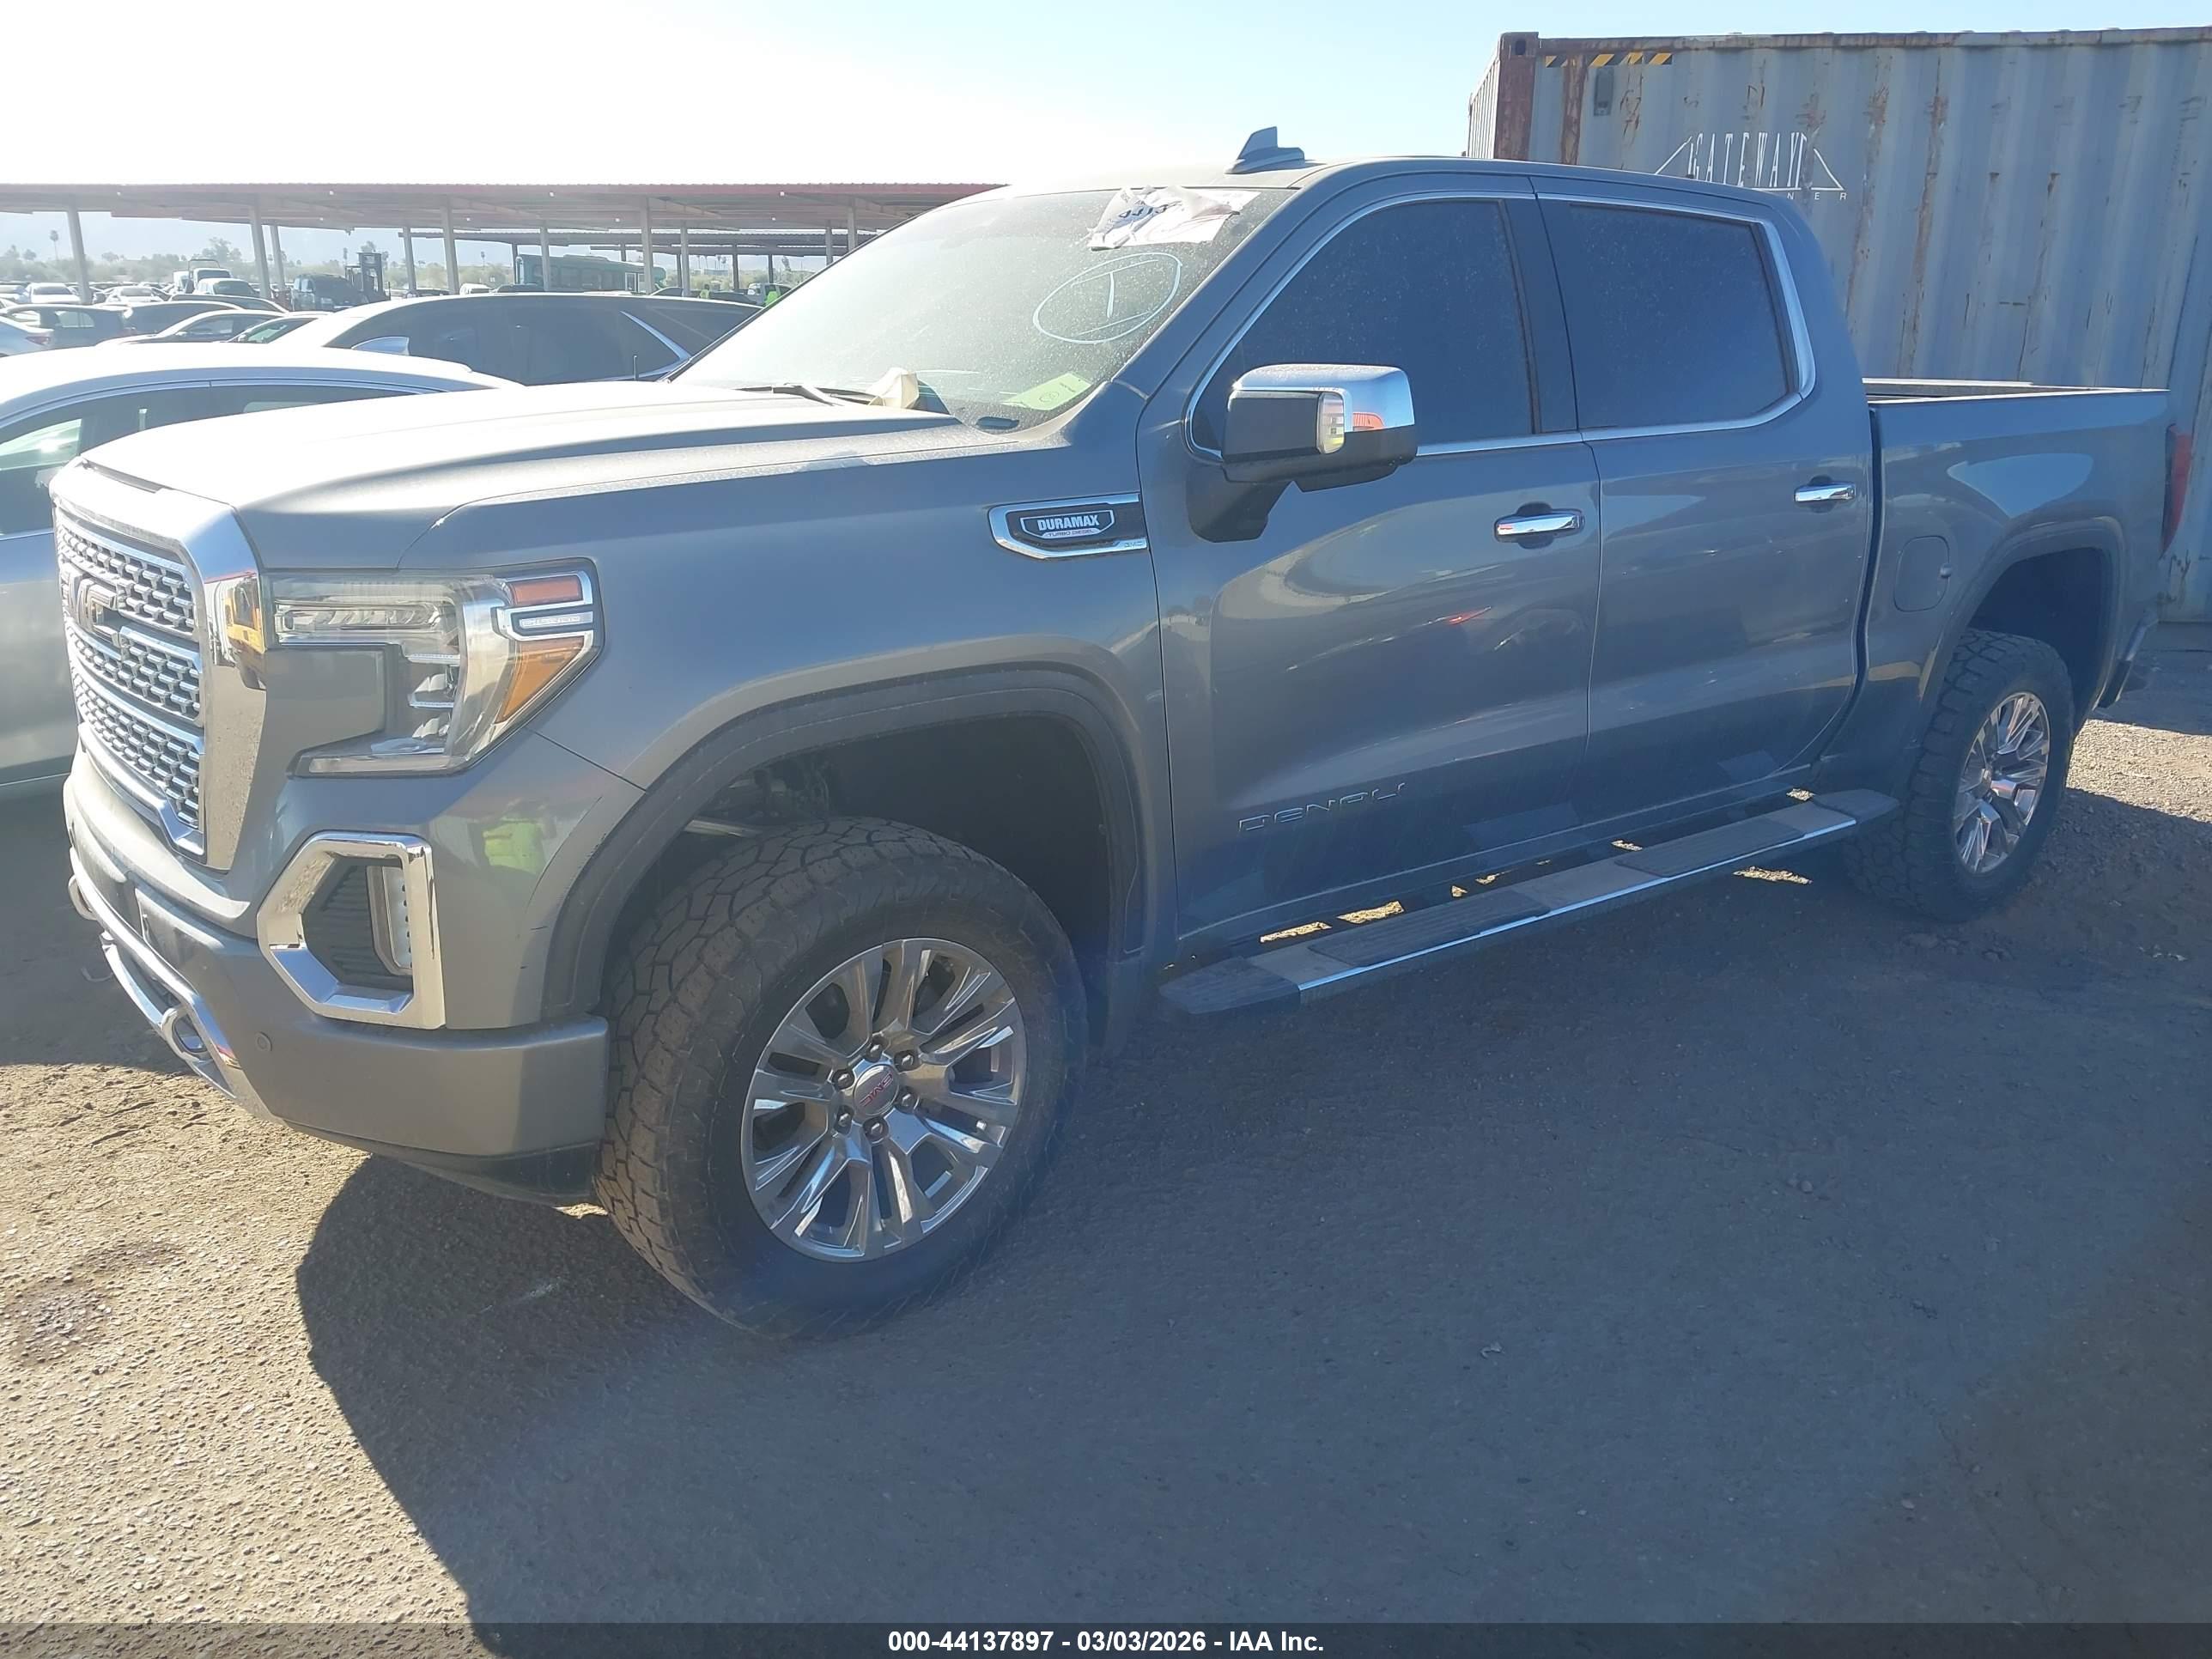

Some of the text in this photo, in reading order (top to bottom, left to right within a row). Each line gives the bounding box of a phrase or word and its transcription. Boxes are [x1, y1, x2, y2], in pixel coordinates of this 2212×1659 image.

[1037, 515, 1100, 531] DURAMAX
[1238, 782, 1406, 832] DENALI
[859, 1072, 894, 1108] GMC
